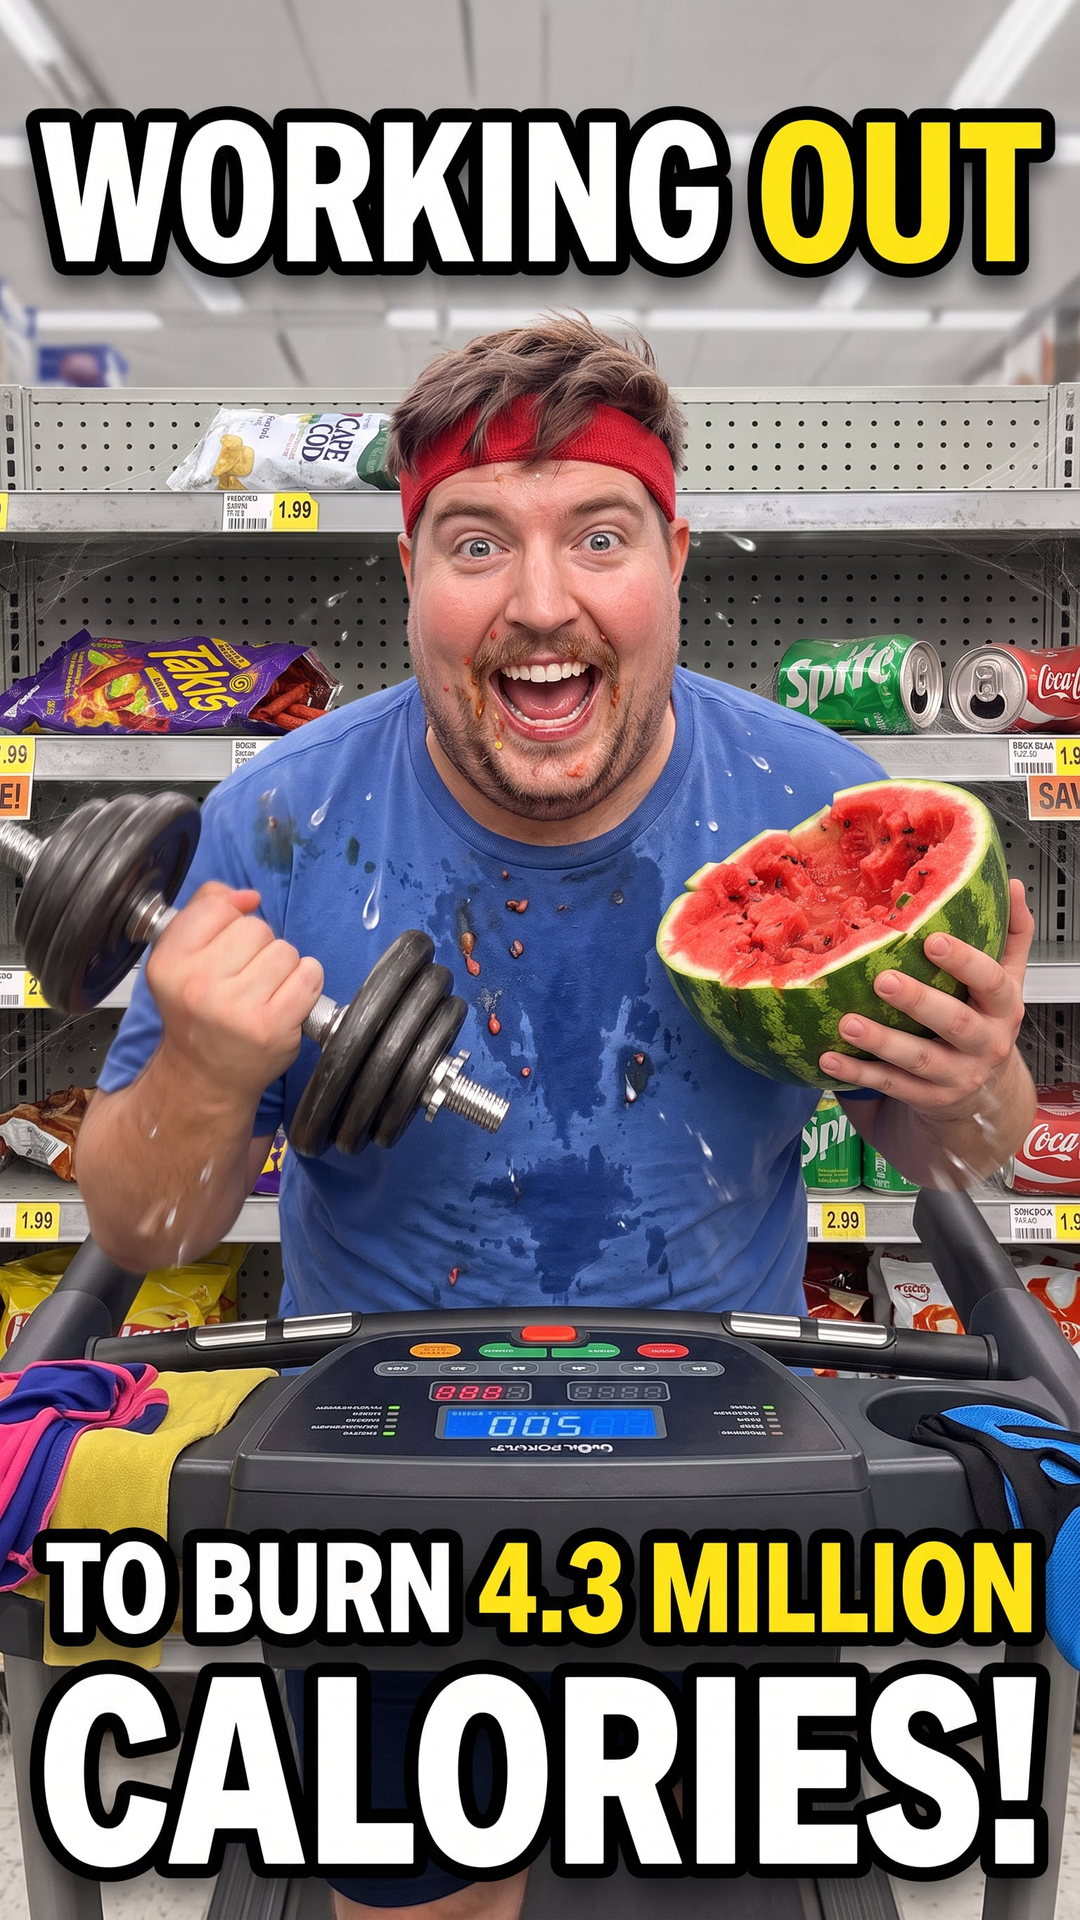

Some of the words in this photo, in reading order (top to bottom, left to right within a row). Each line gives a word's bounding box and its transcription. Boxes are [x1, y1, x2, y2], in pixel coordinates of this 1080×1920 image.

[302, 423, 334, 462] COD
[323, 418, 360, 463] CAPE
[279, 500, 312, 519] 1.99
[147, 644, 240, 711] Takis
[785, 642, 895, 715] Sprite
[0, 745, 27, 764] .99
[21, 1211, 53, 1229] 1.99
[827, 1211, 859, 1229] 2.99
